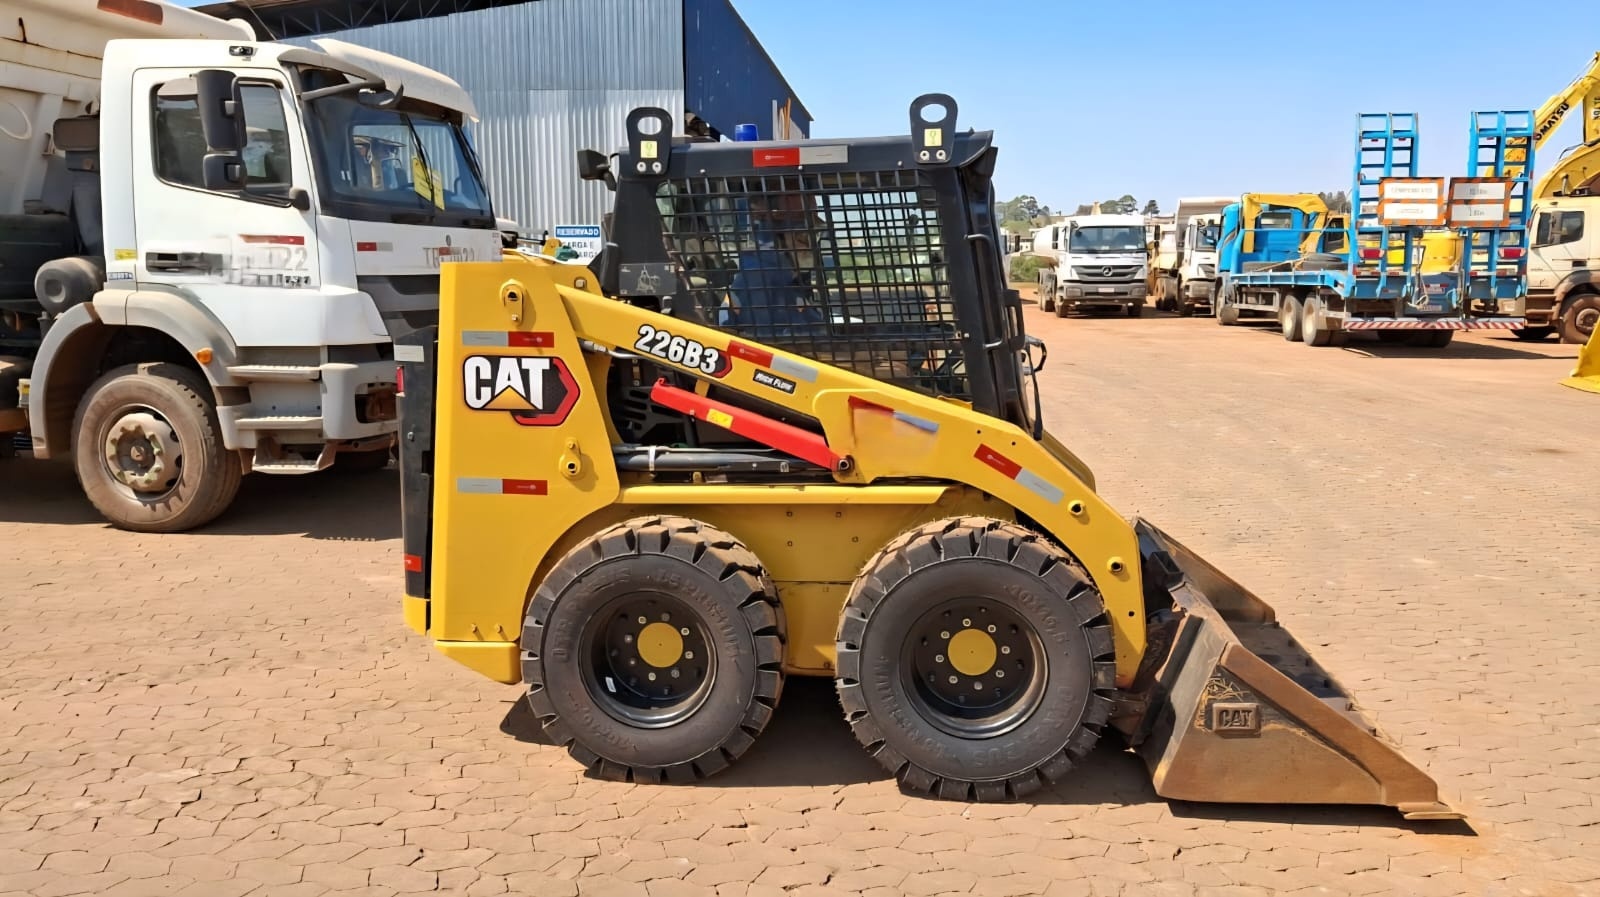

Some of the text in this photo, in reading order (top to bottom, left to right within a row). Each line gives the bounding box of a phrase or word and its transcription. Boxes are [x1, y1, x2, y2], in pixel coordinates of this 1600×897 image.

[1535, 101, 1570, 141] OMATSU
[635, 325, 720, 375] 226B3
[464, 356, 551, 410] CAT
[1220, 709, 1253, 728] CAT
